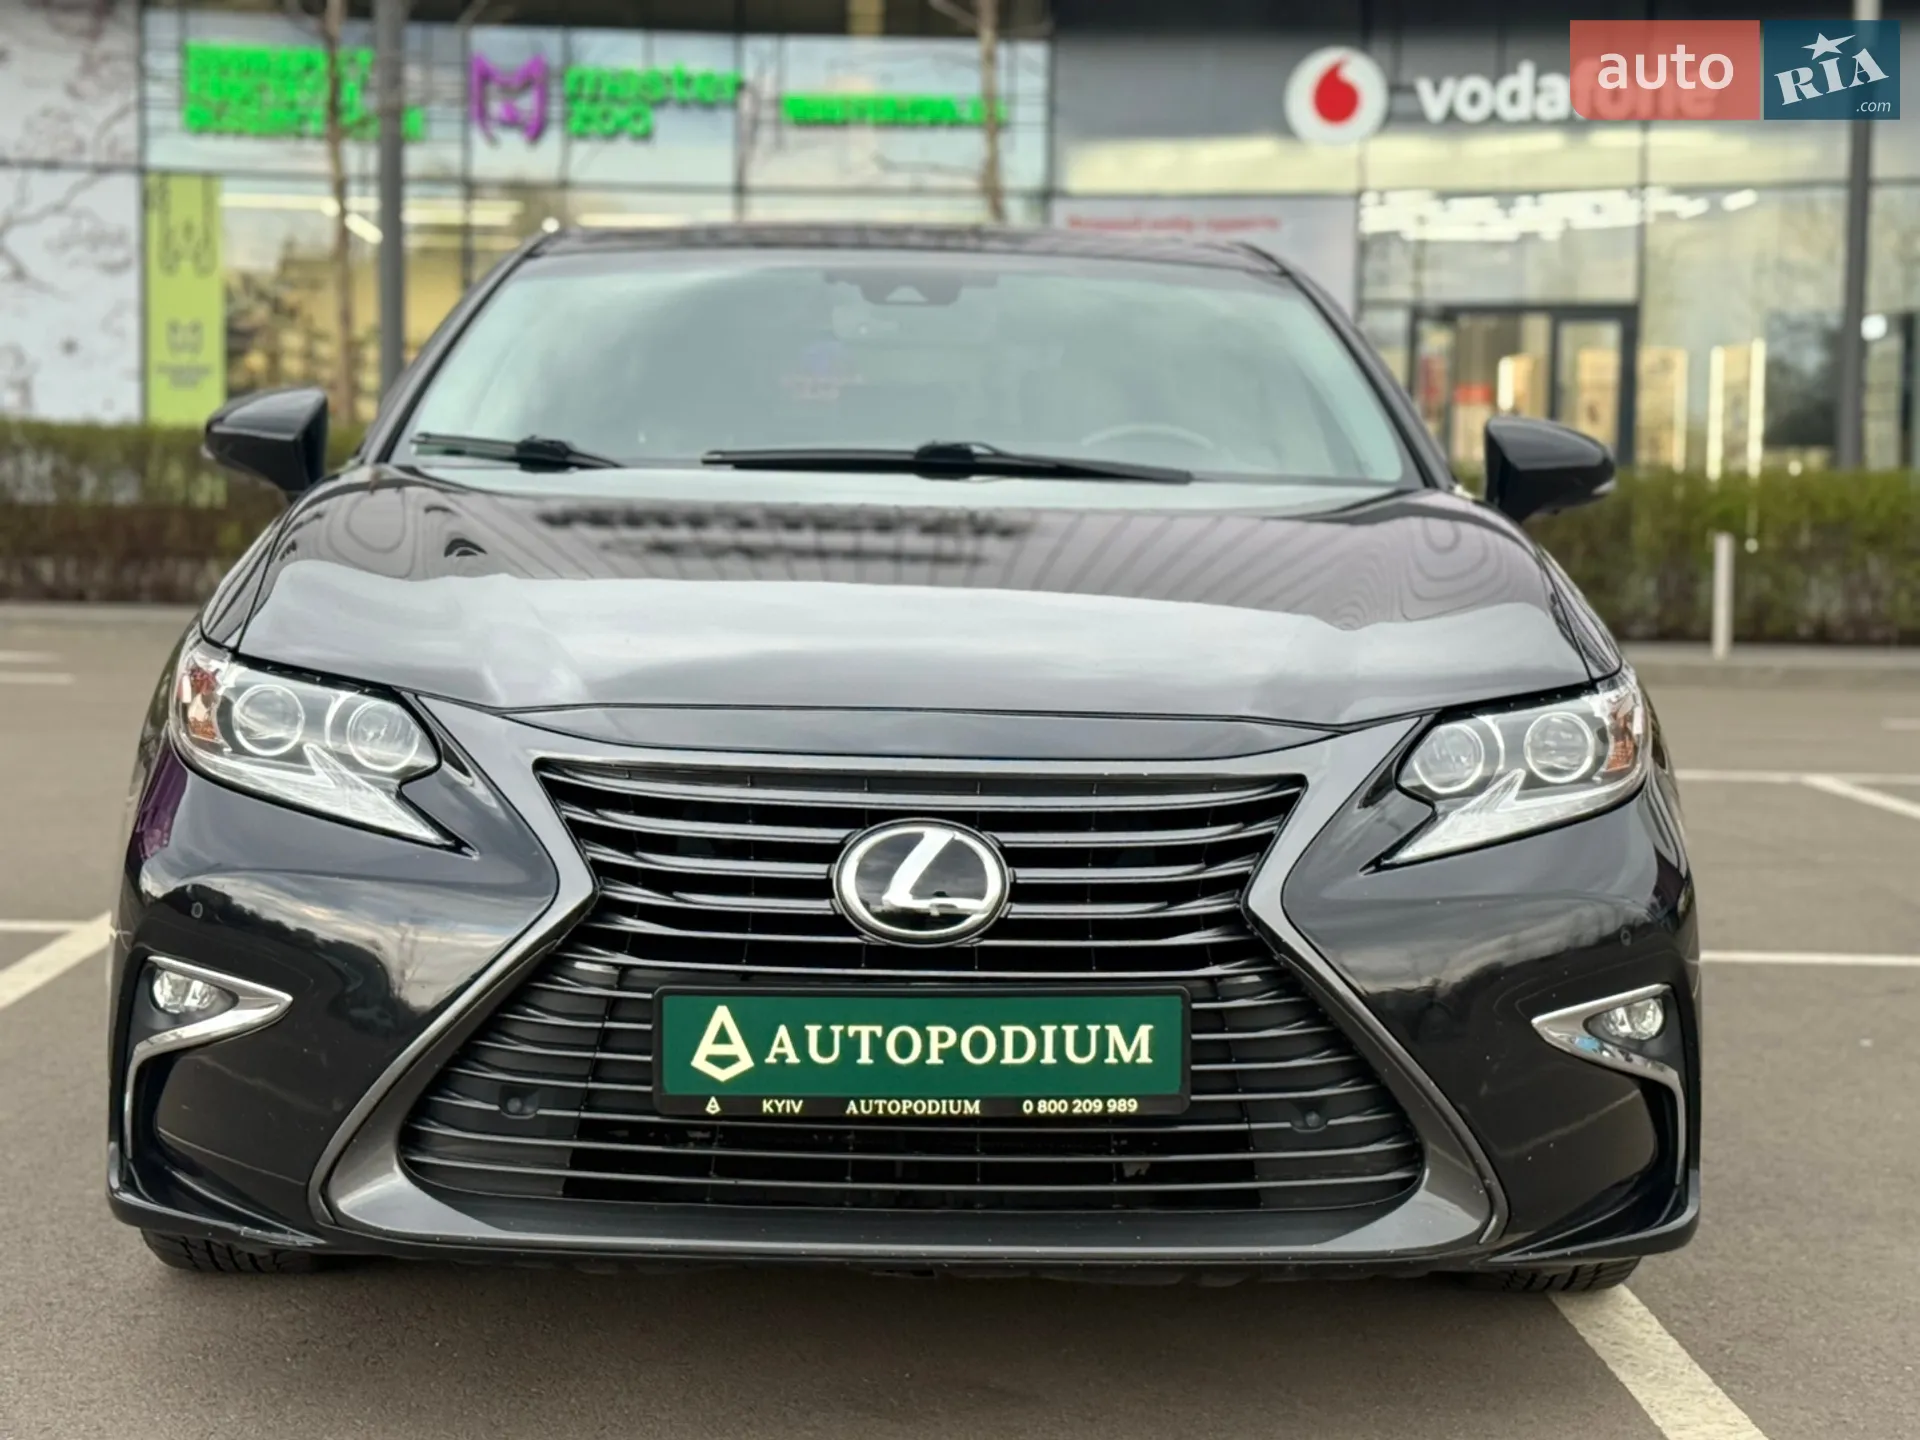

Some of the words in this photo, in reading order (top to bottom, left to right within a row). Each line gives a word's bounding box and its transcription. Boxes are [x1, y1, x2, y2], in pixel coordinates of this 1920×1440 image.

[565, 64, 741, 104] master
[764, 1023, 1154, 1065] AUTOPODIUM
[761, 1098, 804, 1115] KYIV
[844, 1098, 982, 1115] AUTOPODIUM
[1021, 1099, 1034, 1115] 0
[1036, 1098, 1068, 1115] 800
[1071, 1098, 1103, 1114] 209
[1106, 1097, 1139, 1113] 989
